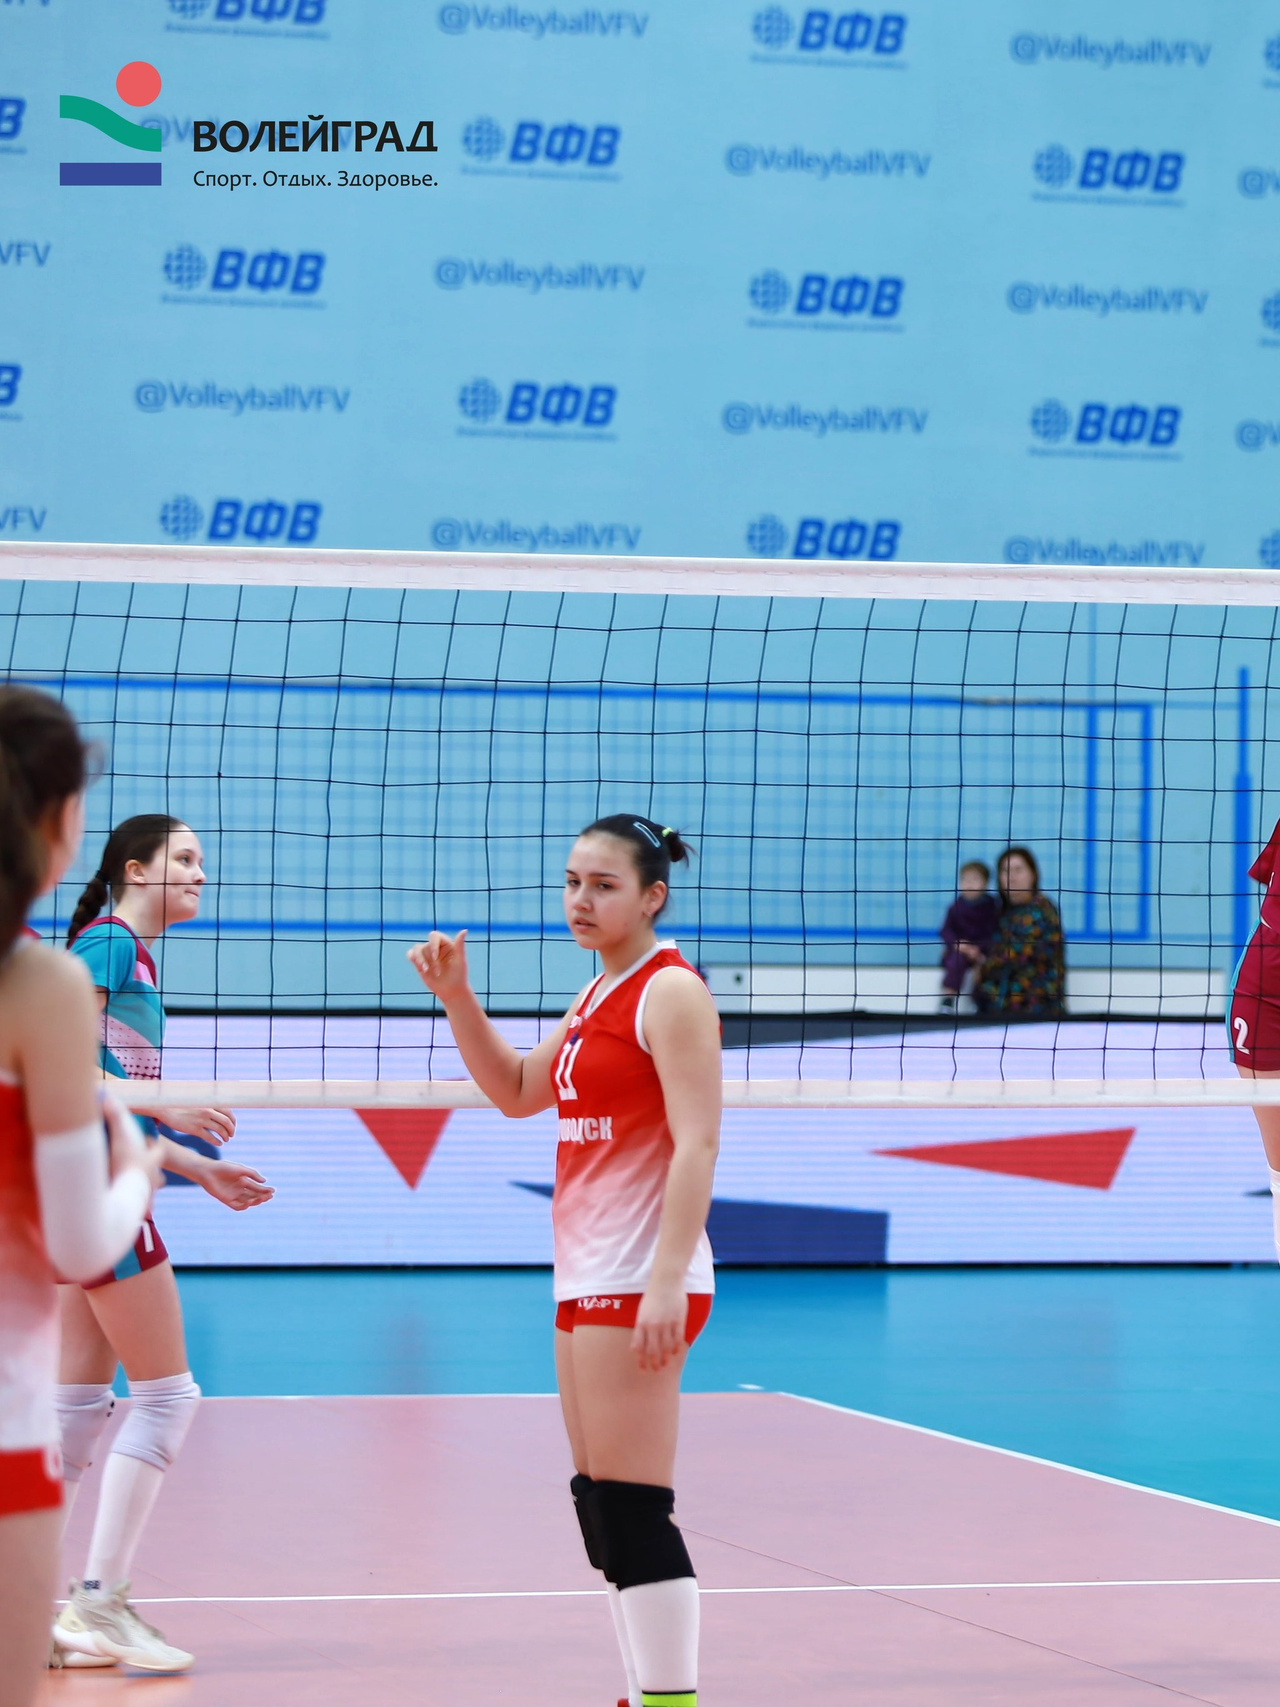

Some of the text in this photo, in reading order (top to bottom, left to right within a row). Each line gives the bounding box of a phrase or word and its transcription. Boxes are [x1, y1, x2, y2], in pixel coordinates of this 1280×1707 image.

[438, 3, 648, 37] @VolleyballVFV
[798, 10, 908, 54] ВФВ
[1010, 33, 1211, 67] @VolleyballVFV
[509, 121, 621, 166] ВФВ
[725, 144, 931, 178] @VolleyballVFV
[1077, 148, 1186, 193] ВФВ
[210, 249, 326, 295] ВФВ
[434, 258, 645, 292] @VolleyballVFV
[795, 273, 904, 319] ВФВ
[1007, 283, 1208, 317] @VolleyballVFV
[134, 381, 350, 416] @VolleyballVFV
[505, 381, 618, 427] ВФВ
[722, 403, 928, 437] @VolleyballVFV
[1075, 402, 1181, 447] ВФВ
[207, 499, 322, 544] ВФВ
[430, 518, 641, 552] @VolleyballVFV
[792, 518, 902, 561] ВФВ
[1233, 1016, 1250, 1055] 2
